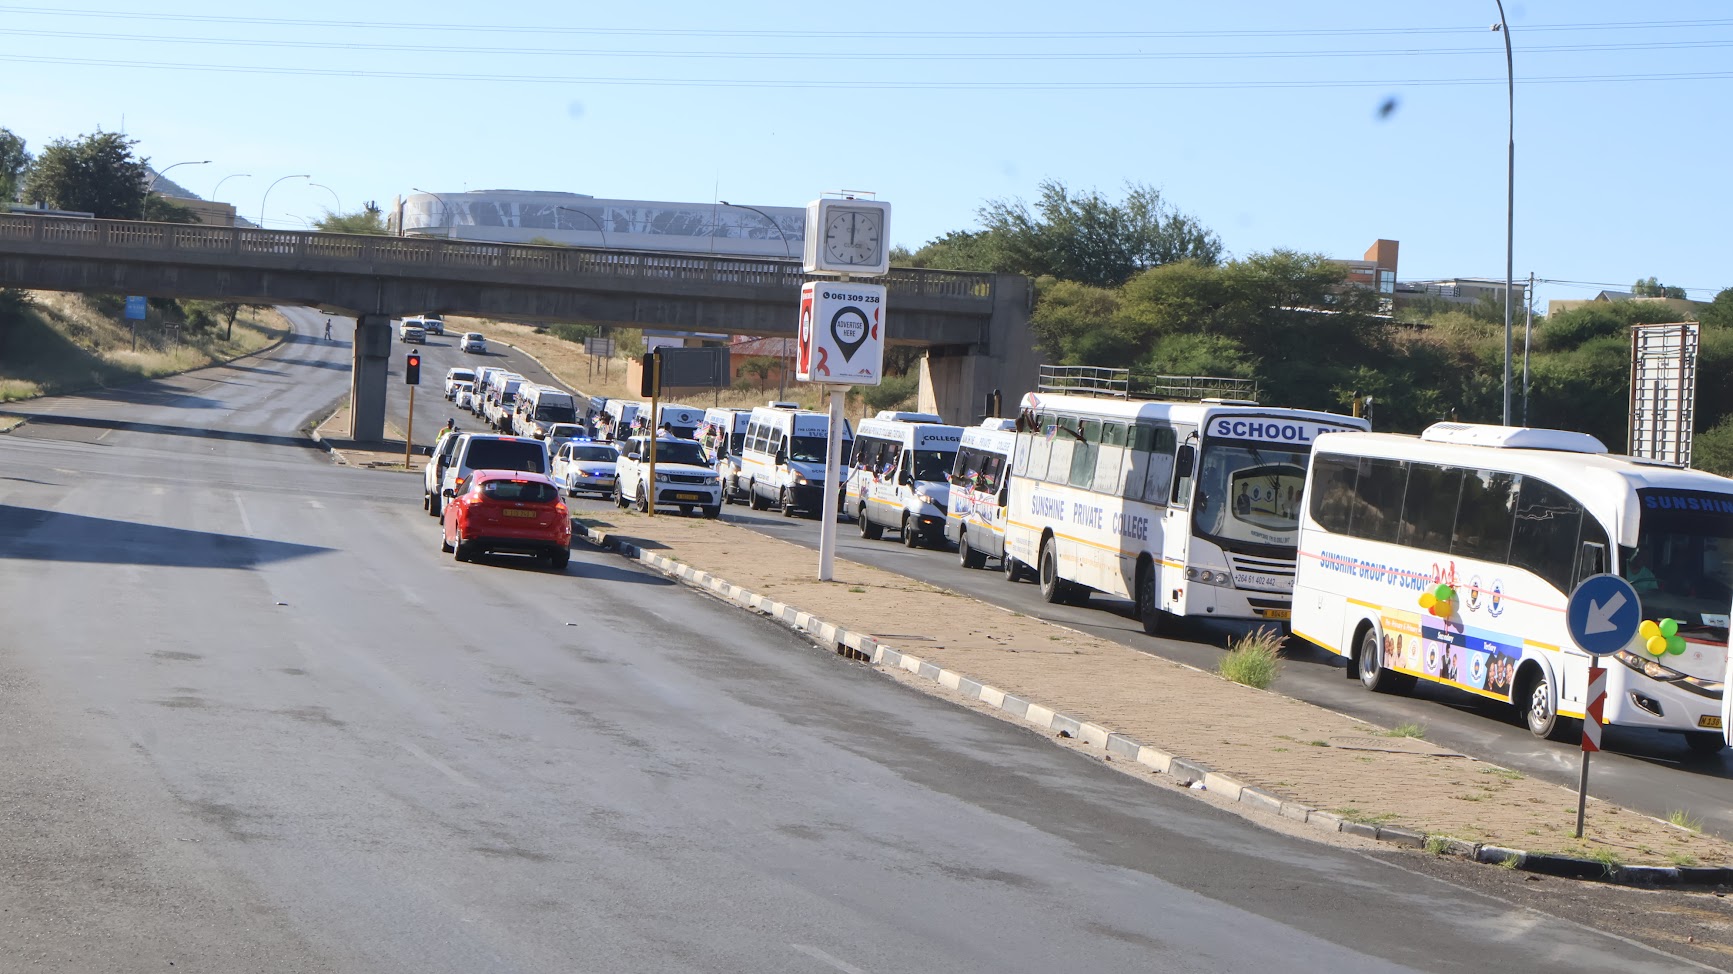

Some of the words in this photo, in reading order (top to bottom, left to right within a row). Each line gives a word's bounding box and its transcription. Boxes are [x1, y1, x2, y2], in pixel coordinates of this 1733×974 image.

[831, 293, 846, 301] 061
[847, 294, 863, 302] 309
[865, 295, 880, 304] 238
[836, 320, 863, 330] ADVERTISE
[843, 329, 856, 337] HERE
[1217, 420, 1310, 441] SCHOOL
[1031, 495, 1065, 521] SUNSHINE
[1073, 502, 1103, 530] PRIVATE
[1112, 512, 1148, 541] COLLEGE
[1320, 550, 1358, 576] SUNSHINE
[1359, 560, 1387, 582] GROUP
[1388, 567, 1399, 586] OF
[1400, 569, 1432, 591] SCHOO
[1234, 574, 1247, 582] +264
[1248, 575, 1255, 583] 61
[1256, 576, 1266, 585] 402
[1266, 577, 1276, 586] 442
